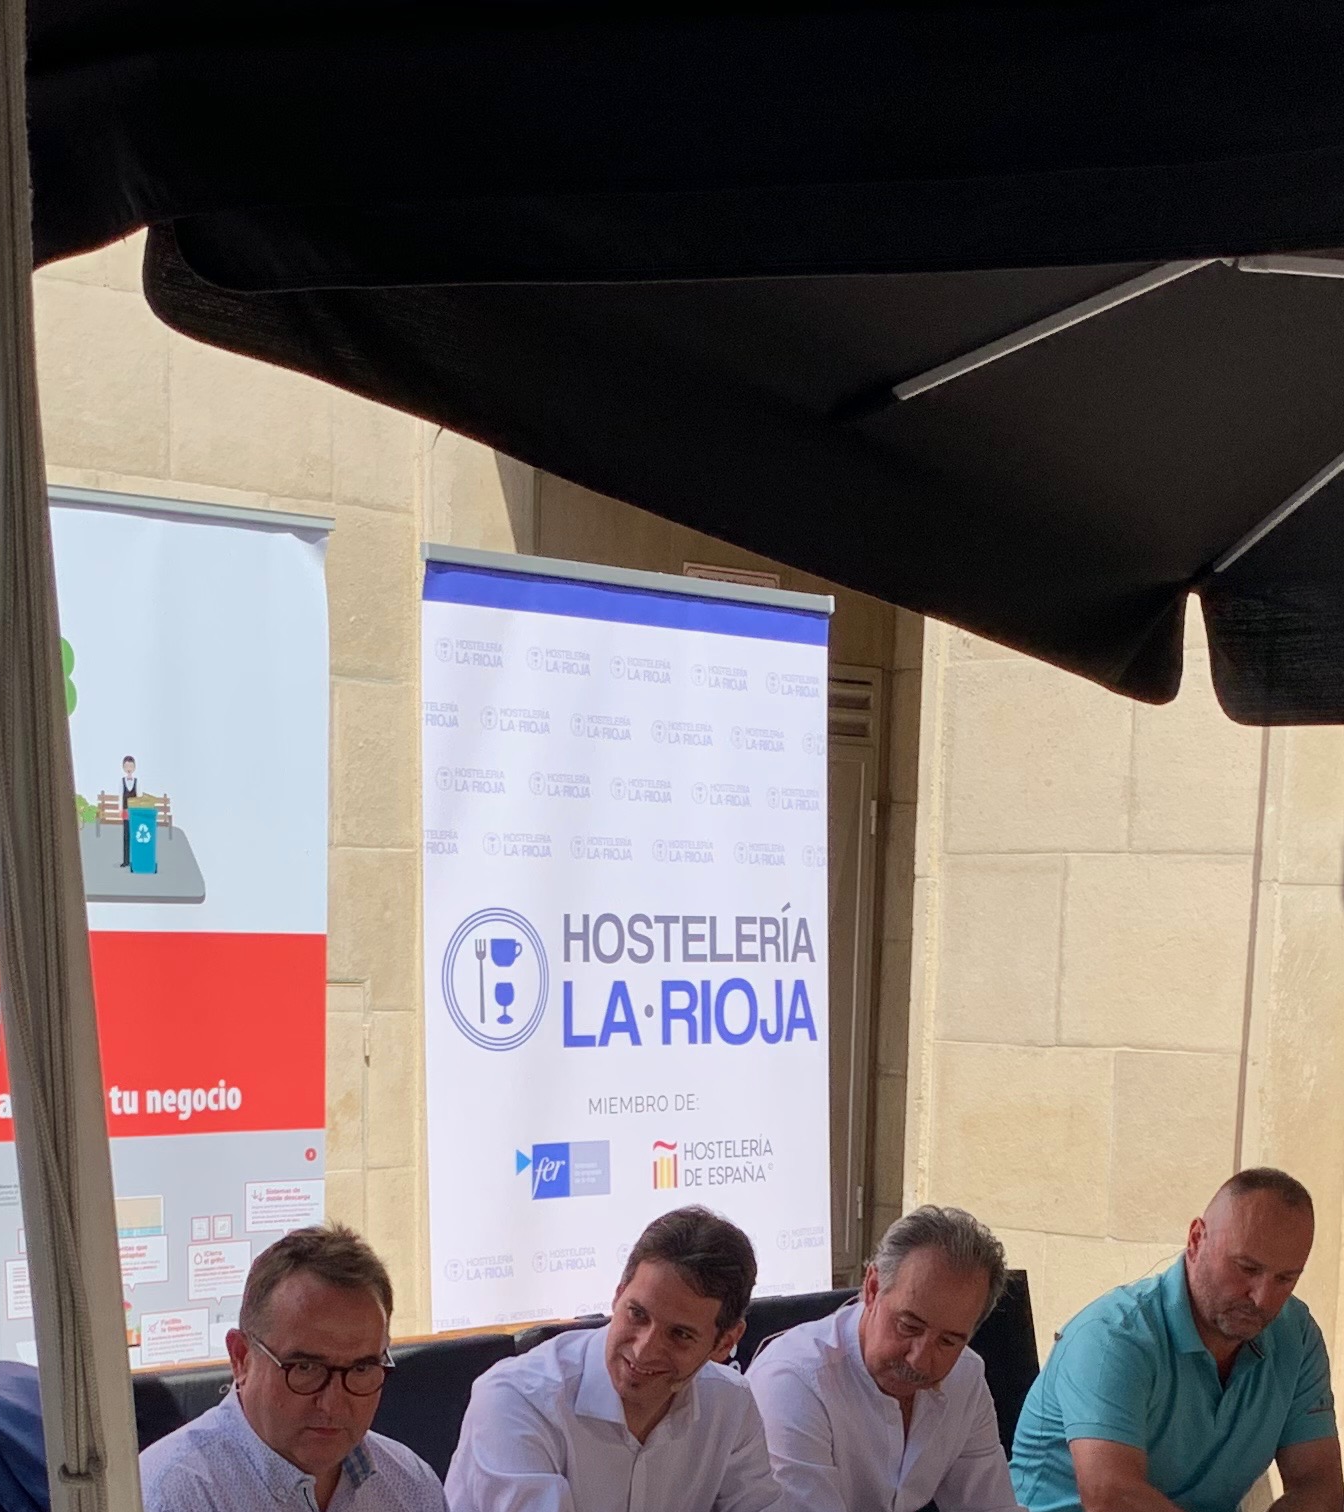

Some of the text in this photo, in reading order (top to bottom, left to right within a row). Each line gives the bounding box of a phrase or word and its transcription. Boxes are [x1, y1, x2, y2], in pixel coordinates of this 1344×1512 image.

[562, 902, 816, 965] HOSTELERÍA
[109, 1079, 243, 1121] tu negocio
[588, 1093, 700, 1115] MIEMBRO DE:
[684, 1133, 774, 1161] HOSTELERÍA
[532, 1156, 566, 1199] fer
[685, 1161, 766, 1187] DE ESPAÑA
